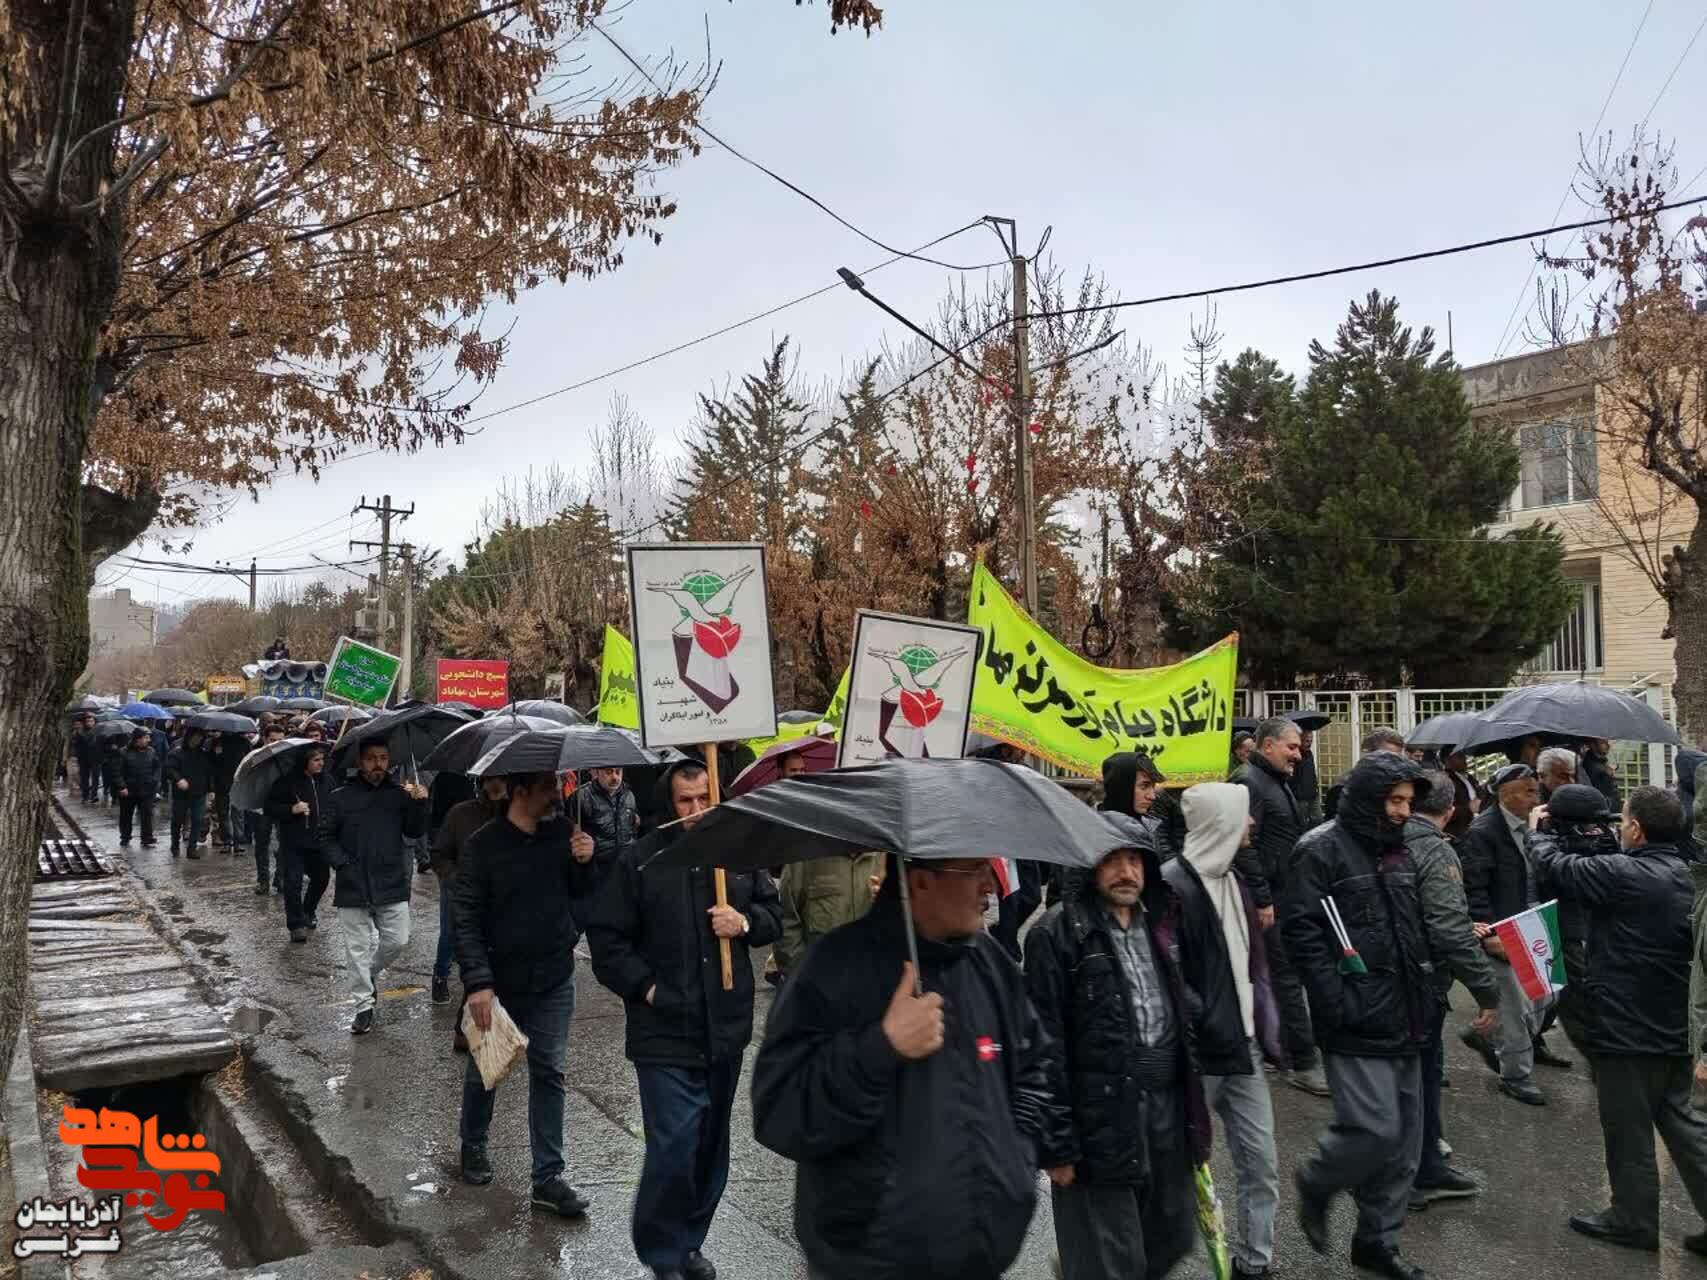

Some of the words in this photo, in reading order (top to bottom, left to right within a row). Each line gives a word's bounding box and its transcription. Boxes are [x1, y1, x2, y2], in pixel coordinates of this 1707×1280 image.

[440, 669, 484, 681] دانشجویی
[485, 671, 506, 682] بسیج
[653, 677, 675, 688] بنیاد
[441, 686, 467, 697] مهاباد
[468, 686, 505, 699] شهرستان
[656, 694, 697, 708] شهید
[1160, 679, 1226, 737] دانشگاه
[1102, 700, 1164, 756] پیام
